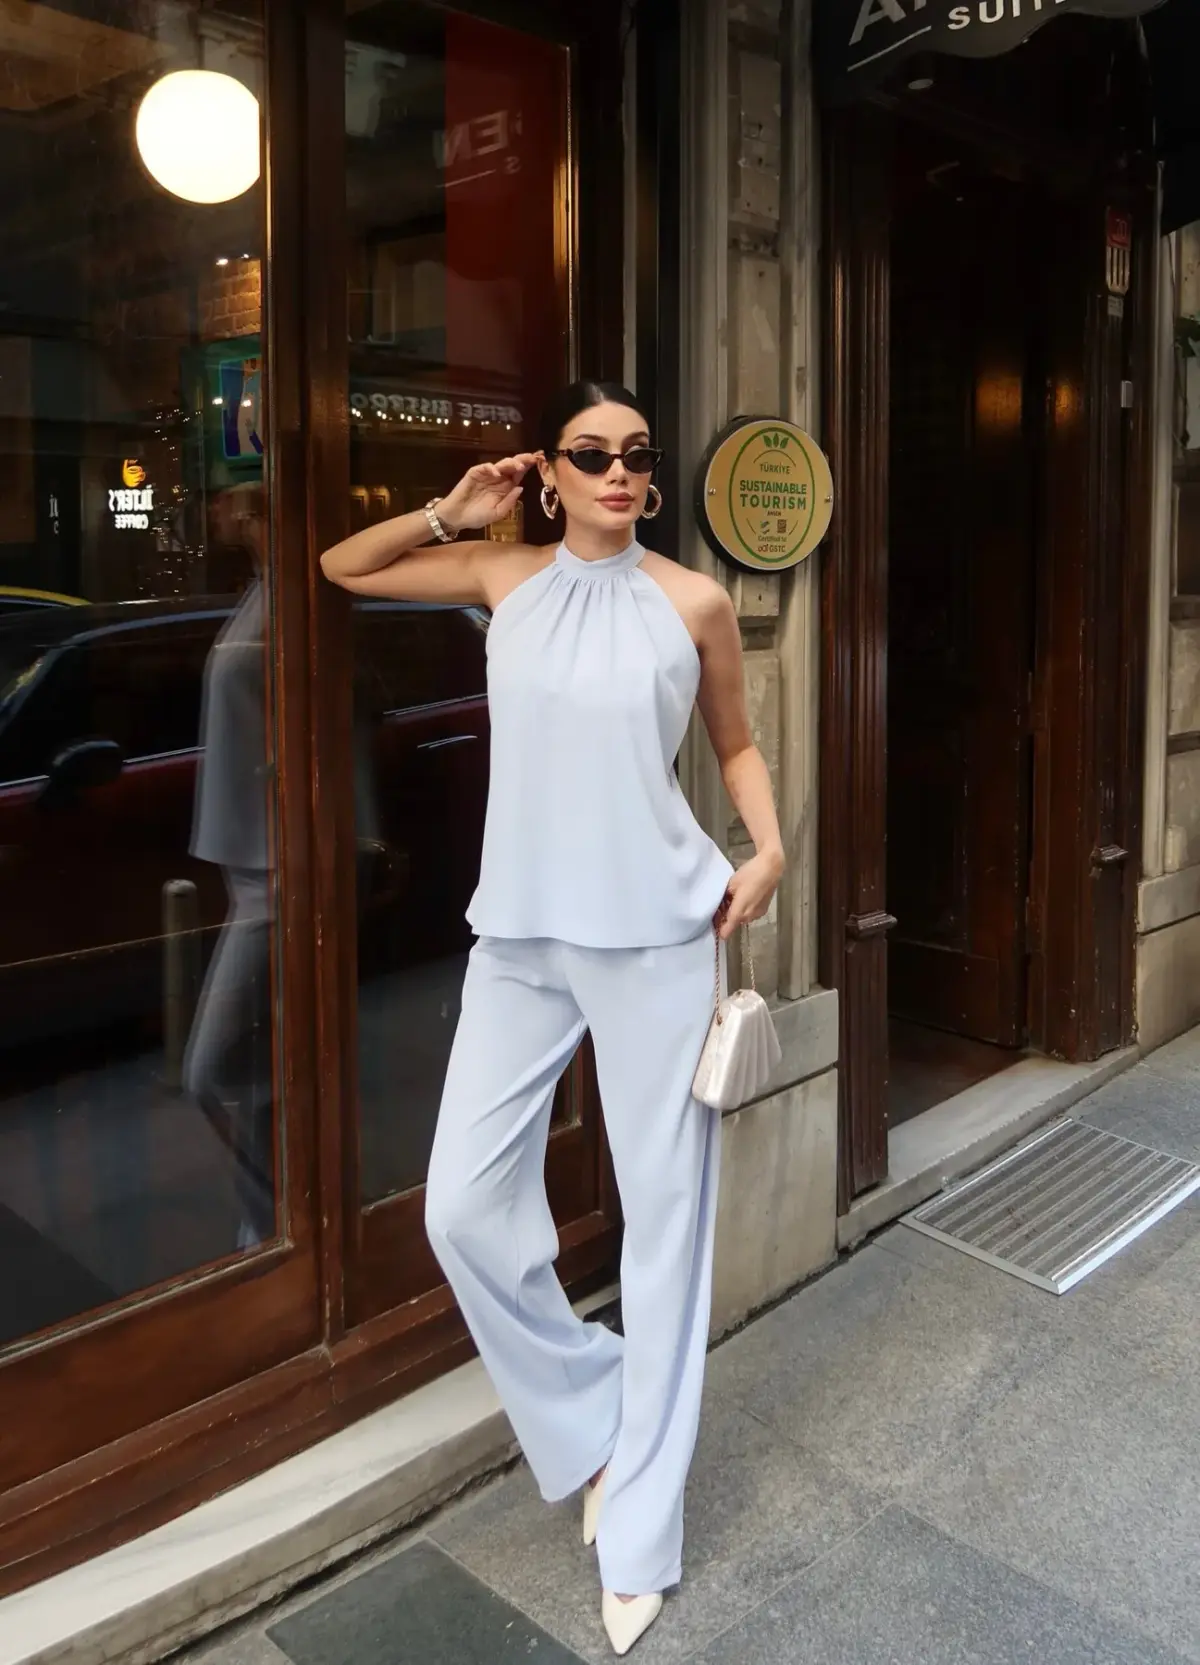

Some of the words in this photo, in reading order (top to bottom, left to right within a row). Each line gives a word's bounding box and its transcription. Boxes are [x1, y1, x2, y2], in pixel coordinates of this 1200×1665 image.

[760, 461, 791, 475] TÜRKİYE
[739, 479, 807, 495] SUSTAINABLE
[740, 494, 807, 510] TOURISM
